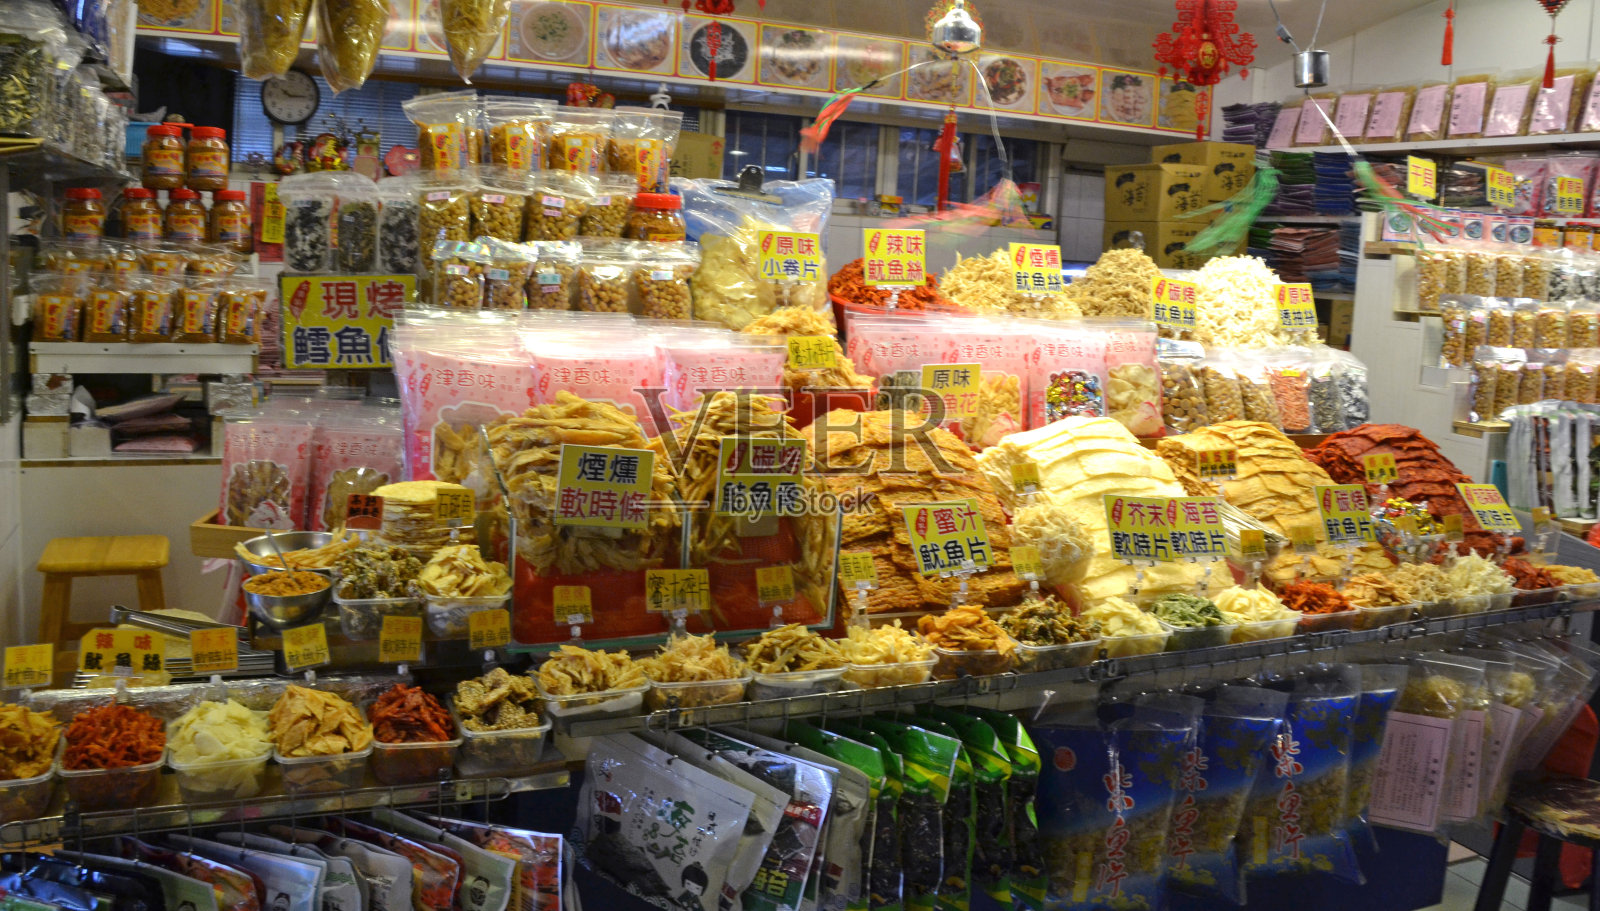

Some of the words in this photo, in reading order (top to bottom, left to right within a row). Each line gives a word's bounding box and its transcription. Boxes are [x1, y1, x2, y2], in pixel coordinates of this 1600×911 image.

[776, 236, 816, 256] 原味
[886, 234, 924, 256] 辣味
[867, 259, 924, 282] 魷魚絲
[1015, 271, 1063, 292] 魷魚絲
[320, 280, 406, 320] 現烤
[1154, 303, 1196, 326] 魷魚絲
[435, 367, 496, 390] 津香味
[553, 367, 611, 387] 津香味
[690, 366, 750, 384] 津香味
[931, 368, 971, 390] 原味
[576, 452, 640, 485] 煙燻
[559, 486, 648, 523] 軟時條
[1126, 501, 1168, 527] 芥末
[1180, 501, 1220, 524] 海苔
[932, 504, 978, 535] 蜜汁
[1326, 516, 1372, 541] 魷魚片
[919, 536, 988, 572] 魷魚片
[96, 632, 152, 651] 辣味
[84, 652, 161, 672] 魷魚絲
